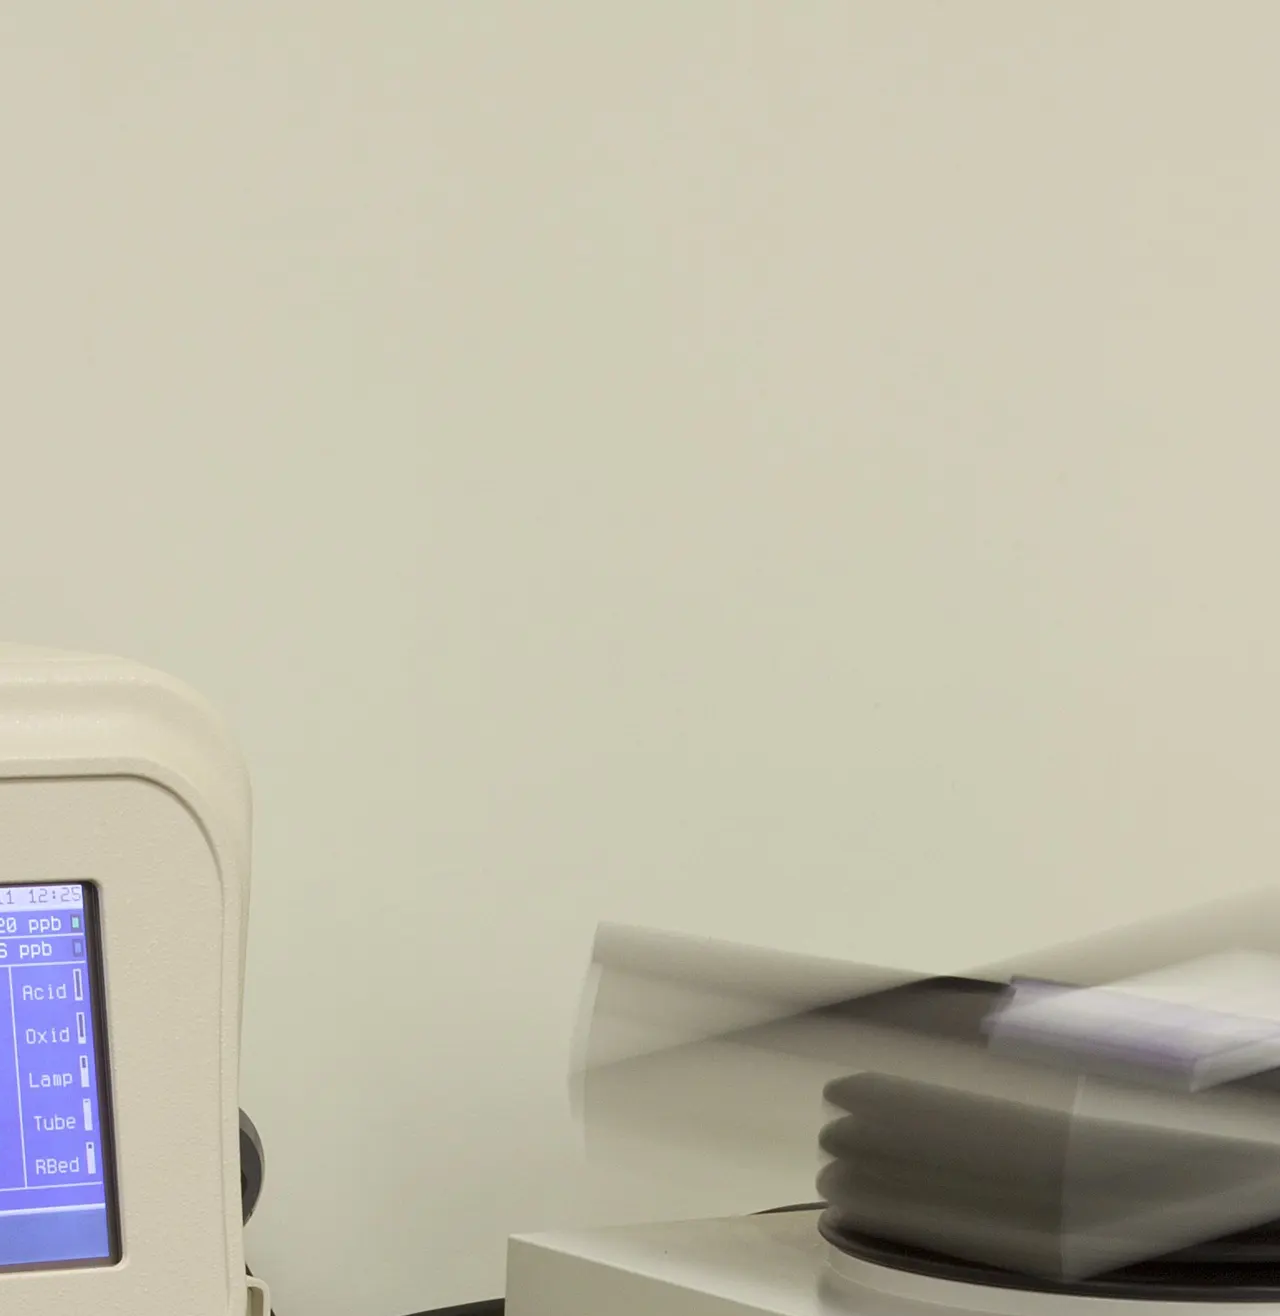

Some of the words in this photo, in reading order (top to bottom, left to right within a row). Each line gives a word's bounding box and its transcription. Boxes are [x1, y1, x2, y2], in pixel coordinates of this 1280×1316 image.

[28, 886, 82, 904] 12:25
[28, 915, 62, 934] ppb
[19, 940, 53, 960] ppb
[22, 983, 68, 1002] Acid
[25, 1026, 71, 1046] Oxid
[28, 1070, 74, 1089] Lamp
[33, 1113, 78, 1132] Tube
[34, 1156, 81, 1176] RBed
